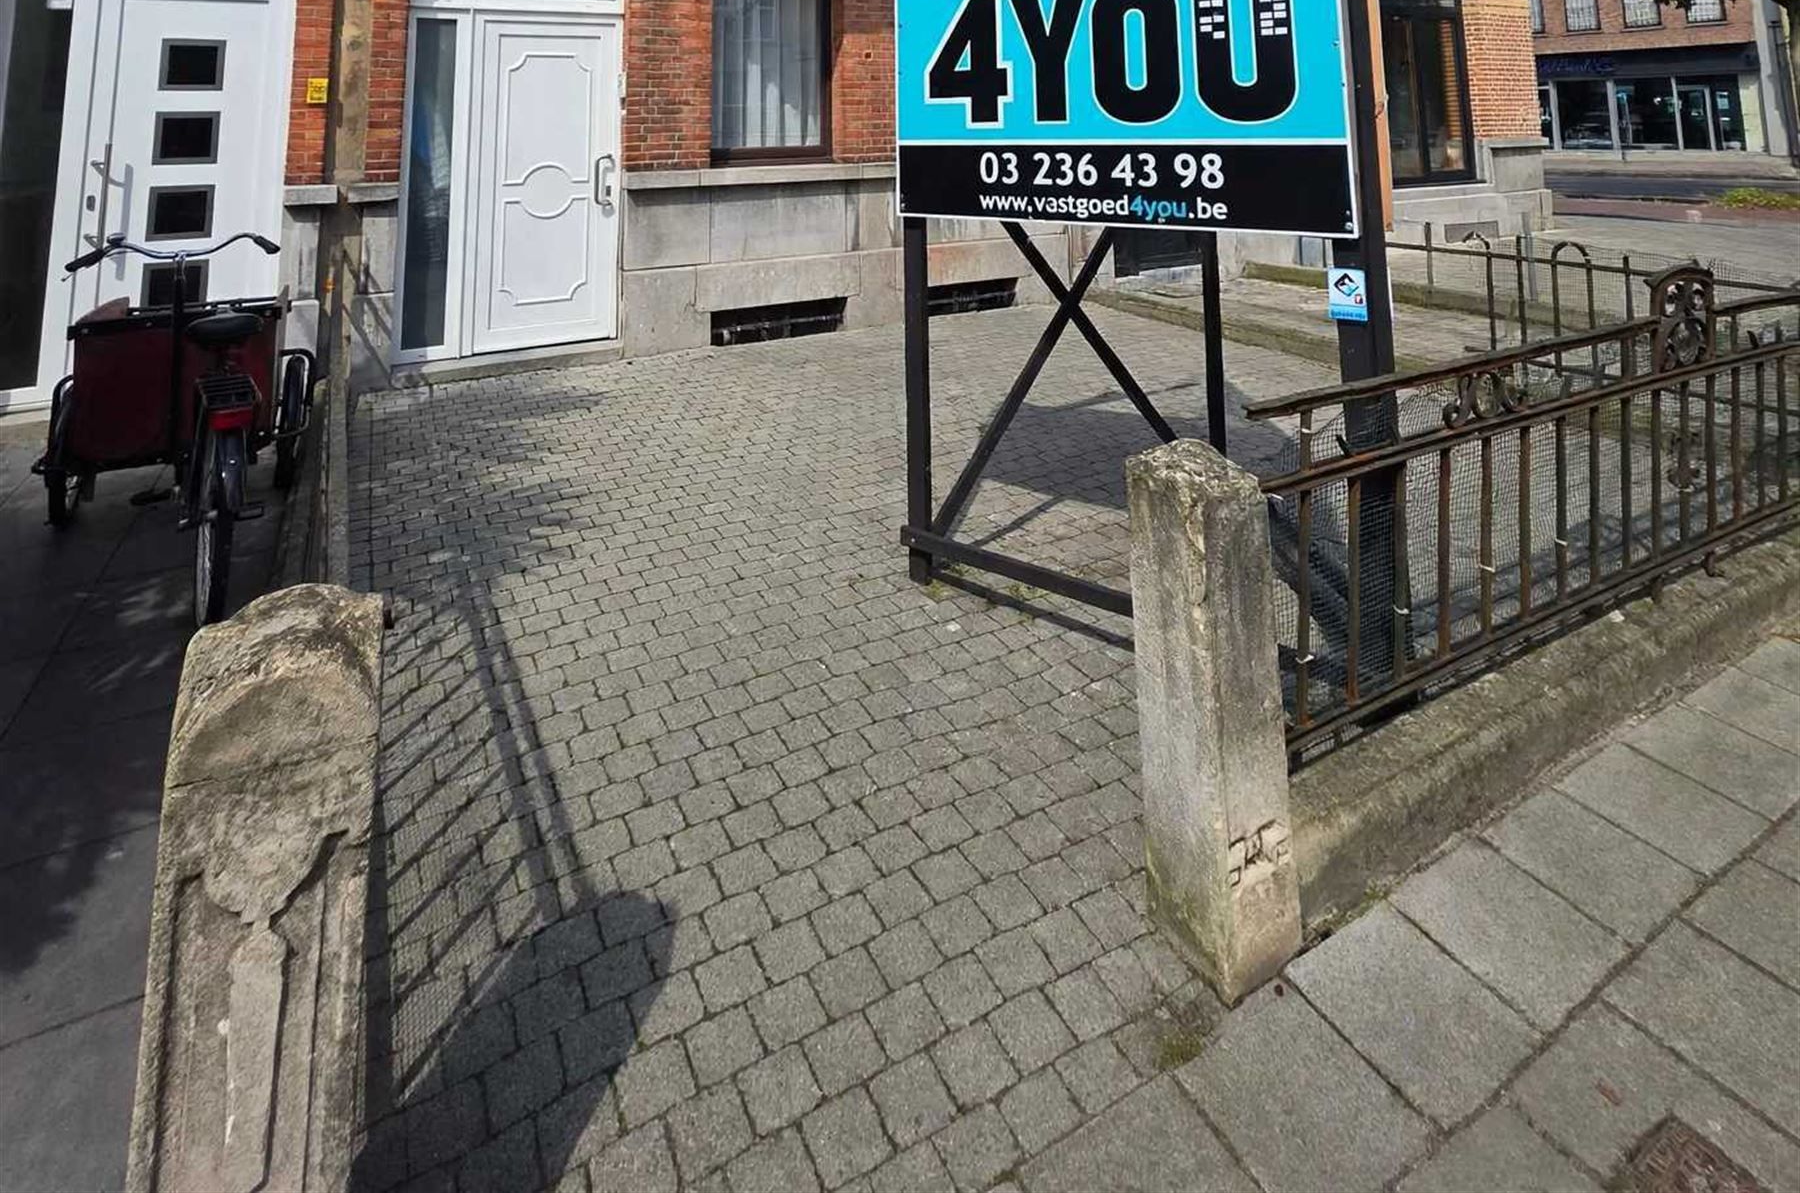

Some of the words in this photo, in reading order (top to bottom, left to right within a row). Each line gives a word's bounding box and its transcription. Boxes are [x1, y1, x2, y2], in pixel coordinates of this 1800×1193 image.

[979, 151, 1020, 186] 03
[1033, 151, 1099, 187] 236
[1110, 152, 1159, 188] 43
[1173, 152, 1226, 190] 98
[979, 193, 1229, 221] www.vastgoed4you.be
